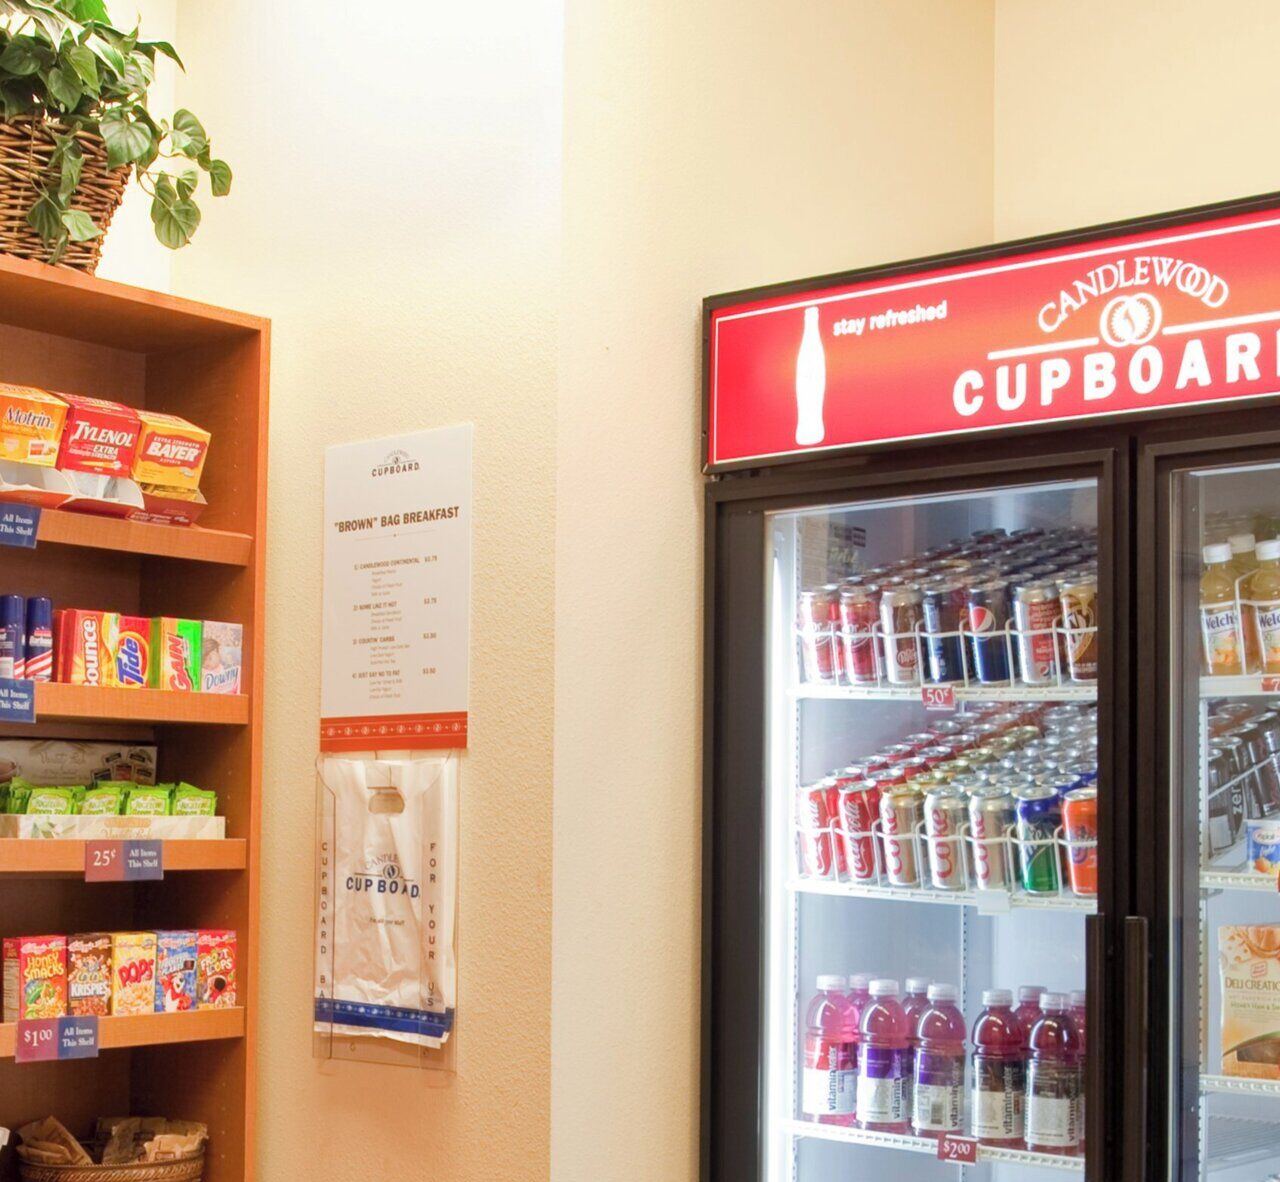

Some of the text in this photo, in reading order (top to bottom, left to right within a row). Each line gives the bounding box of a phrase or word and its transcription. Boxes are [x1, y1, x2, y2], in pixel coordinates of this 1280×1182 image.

[1038, 255, 1233, 334] CANDLEWOOD
[832, 299, 948, 338] stay refreshed
[5, 406, 51, 429] Motrin
[70, 420, 135, 447] TYLENOL
[145, 441, 200, 463] BAYER
[371, 462, 420, 477] CUPBOARD
[2, 512, 33, 525] All Items
[380, 514, 401, 528] BAG
[403, 505, 460, 525] BREAKFAST
[0, 523, 33, 537] This Shelf
[116, 637, 144, 686] Tide
[169, 632, 193, 690] GAIN
[204, 666, 240, 691] Downy
[9, 689, 28, 700] Items
[926, 688, 950, 704] 50¢
[13, 700, 30, 711] Shelf
[93, 848, 117, 867] 25¢
[128, 848, 157, 858] All Items
[127, 859, 158, 869] This Shelf
[26, 952, 60, 969] HONEY
[24, 963, 65, 980] SMACKS
[118, 958, 155, 987] POPS
[70, 981, 109, 998] KRISPIES
[1225, 976, 1244, 989] DELI
[64, 1026, 93, 1036] All Items
[62, 1036, 95, 1048] This Shelf
